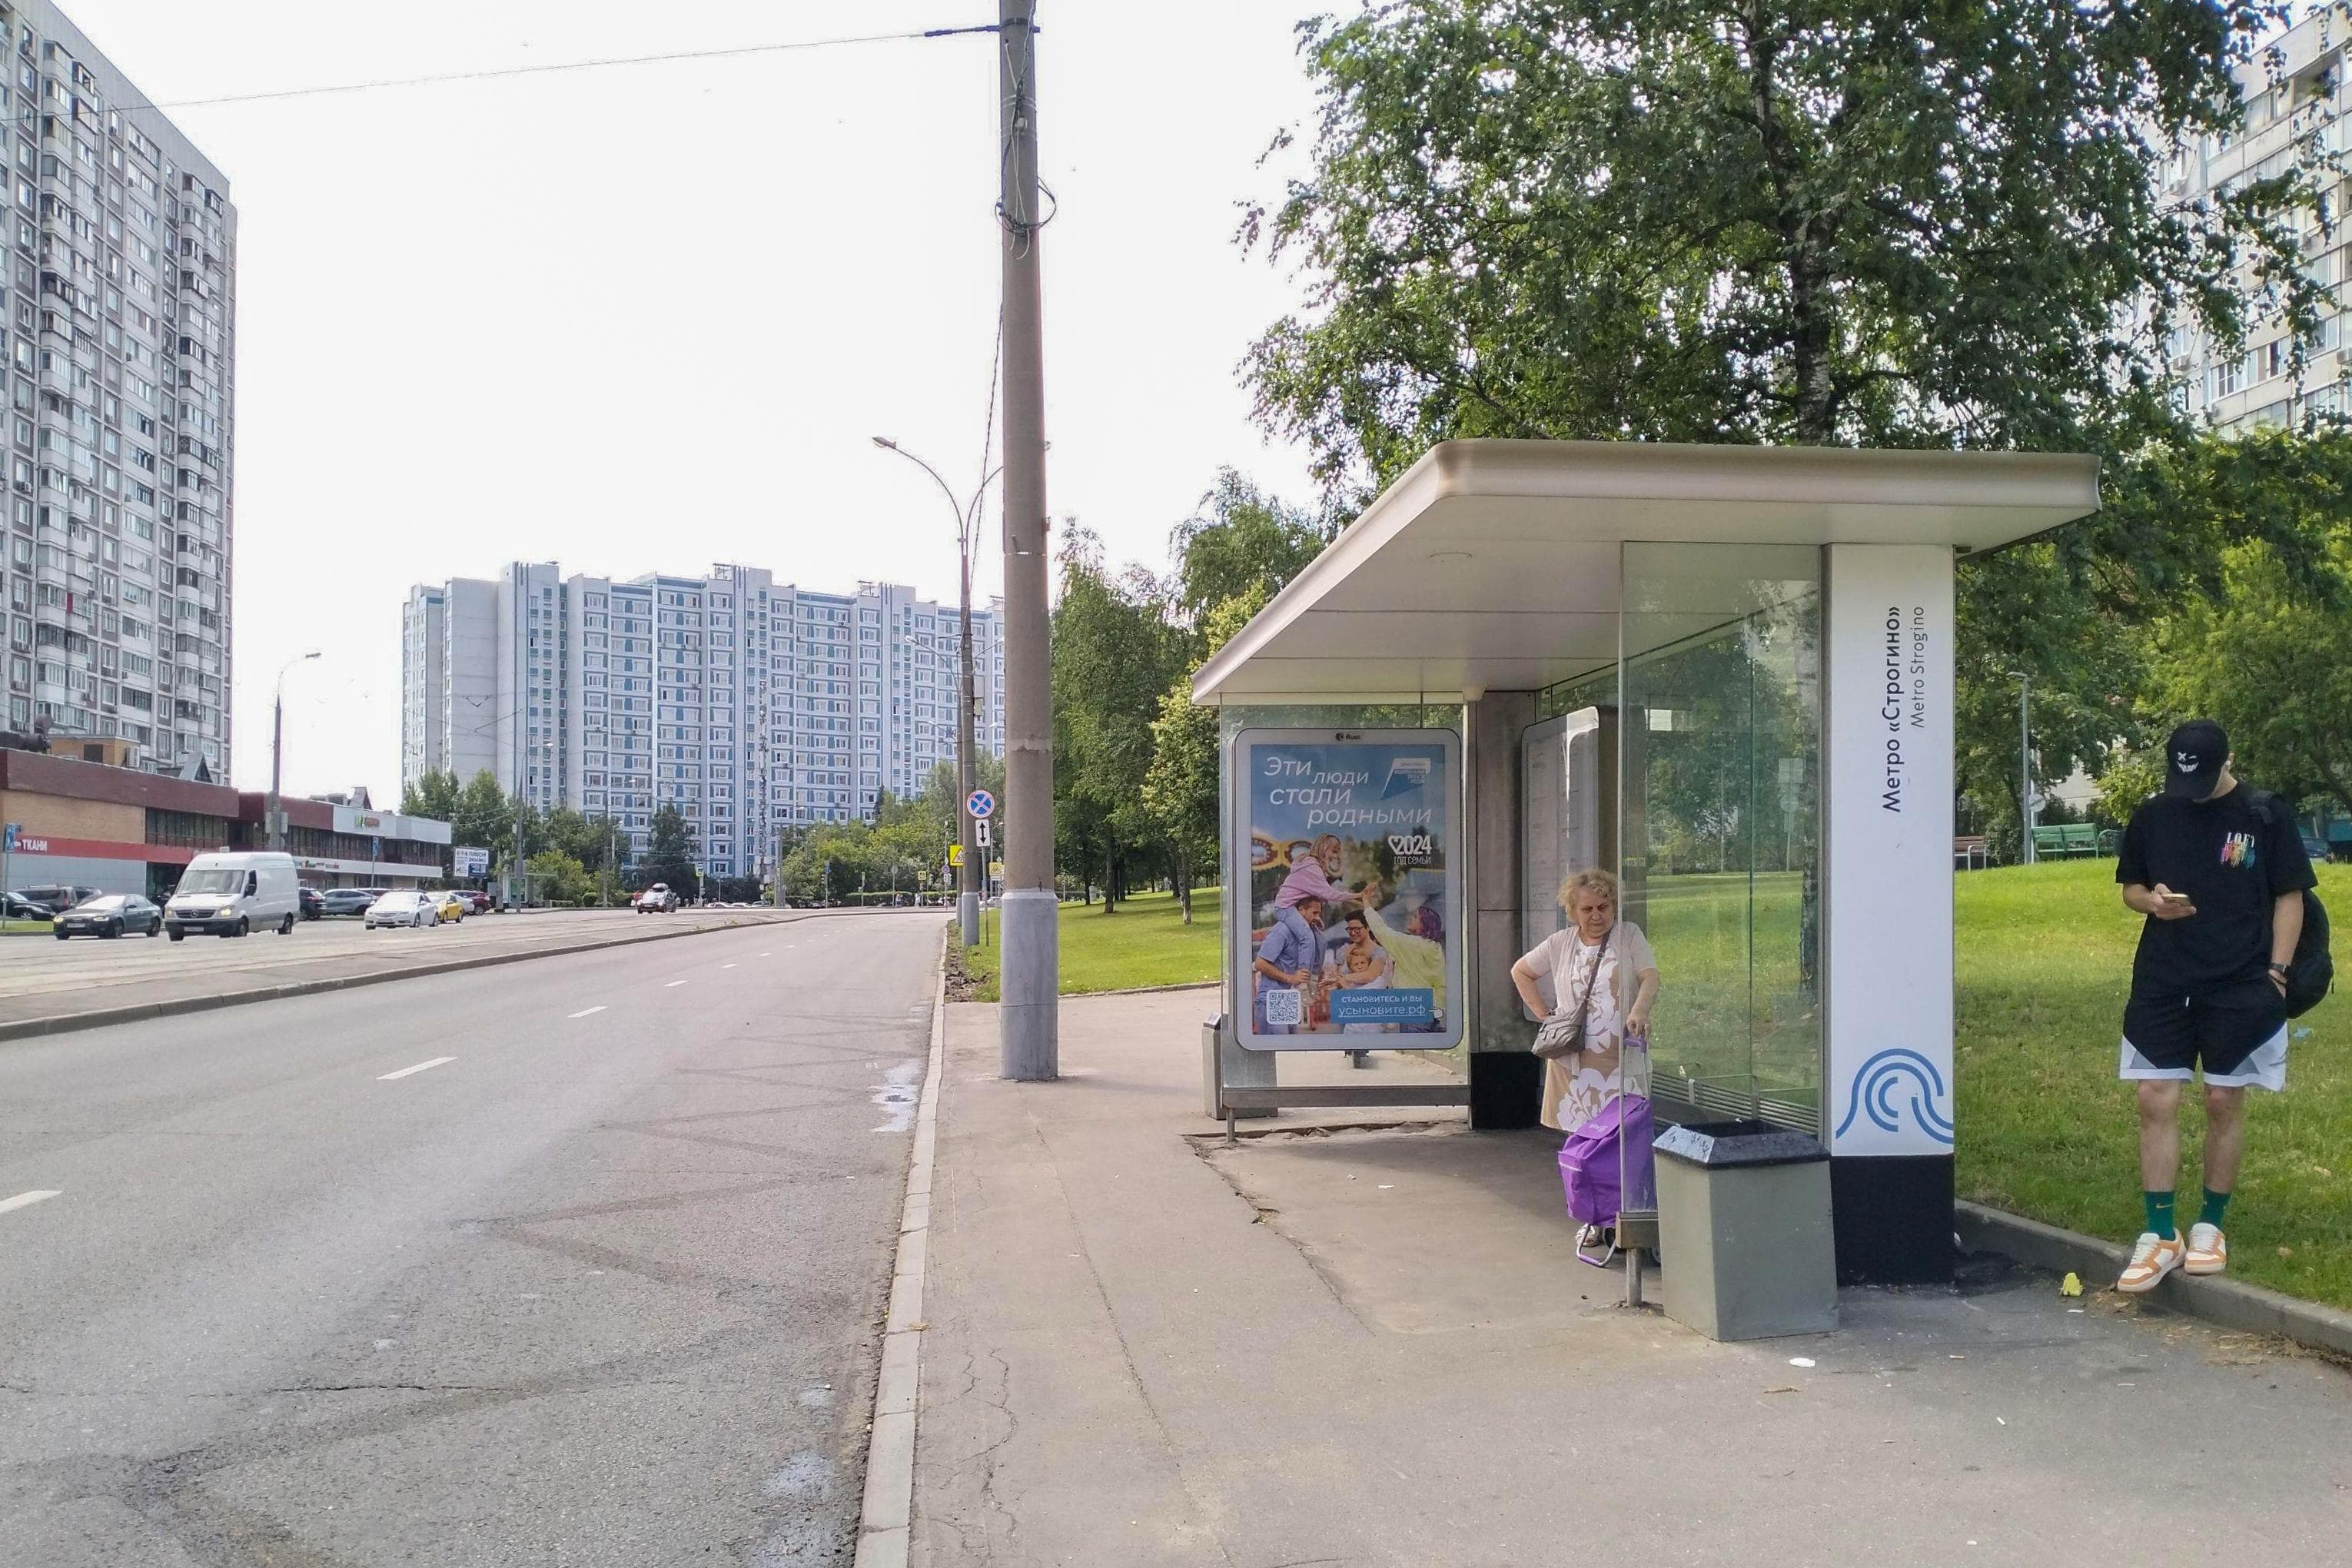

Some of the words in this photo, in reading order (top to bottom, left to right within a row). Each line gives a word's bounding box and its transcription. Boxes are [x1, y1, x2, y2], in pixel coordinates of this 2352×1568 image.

[1910, 606, 1928, 674] Strogino
[1882, 606, 1905, 732] «Строгино»
[1910, 679, 1925, 729] Metro
[1264, 756, 1312, 776] Эти
[1882, 739, 1905, 813] Метро
[1311, 772, 1369, 786] люди
[1269, 789, 1352, 806] стали
[1307, 809, 1433, 829] родными
[22, 839, 48, 852] ТКАНИ
[1395, 835, 1432, 855] 2024
[1338, 1004, 1426, 1017] усыновите.рф
